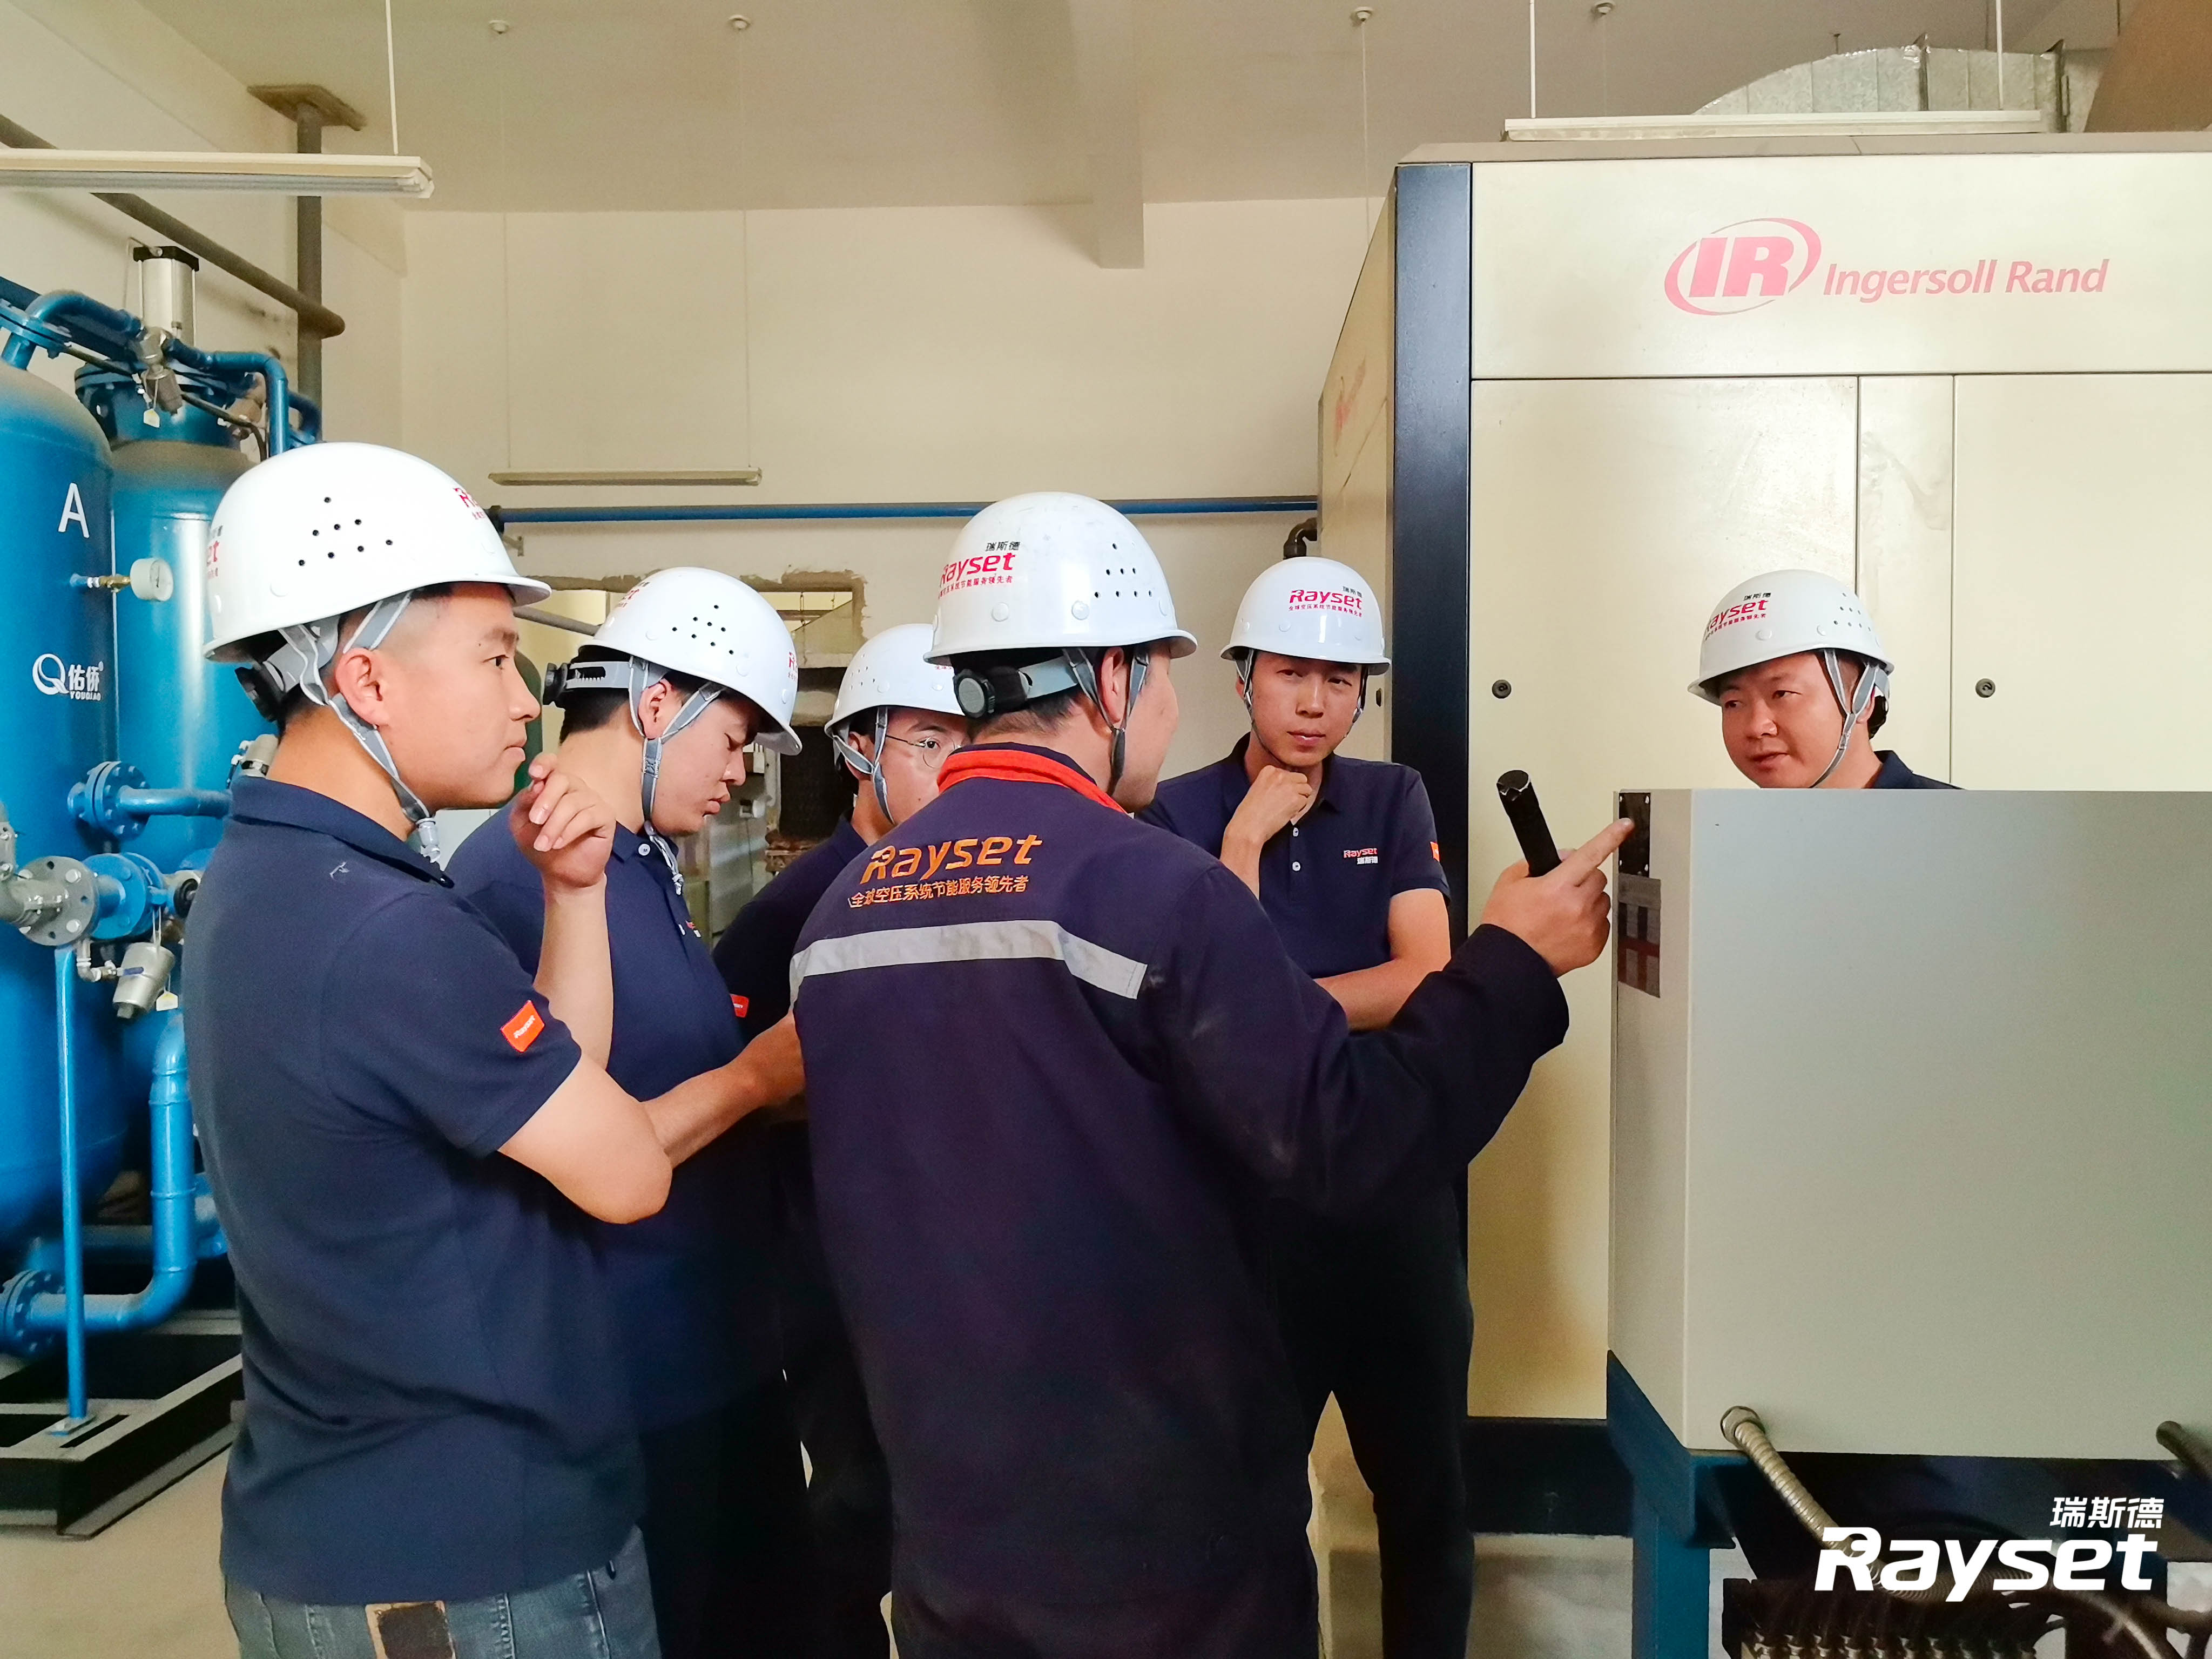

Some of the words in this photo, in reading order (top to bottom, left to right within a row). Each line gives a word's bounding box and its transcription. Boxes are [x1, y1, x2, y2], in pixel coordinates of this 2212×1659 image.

[1689, 237, 1795, 298] IR
[1823, 259, 1998, 303] Ingersoll
[2005, 259, 2110, 293] Rand
[58, 482, 90, 538] A
[1289, 589, 1363, 610] Rayset
[859, 834, 1043, 885] Rayset
